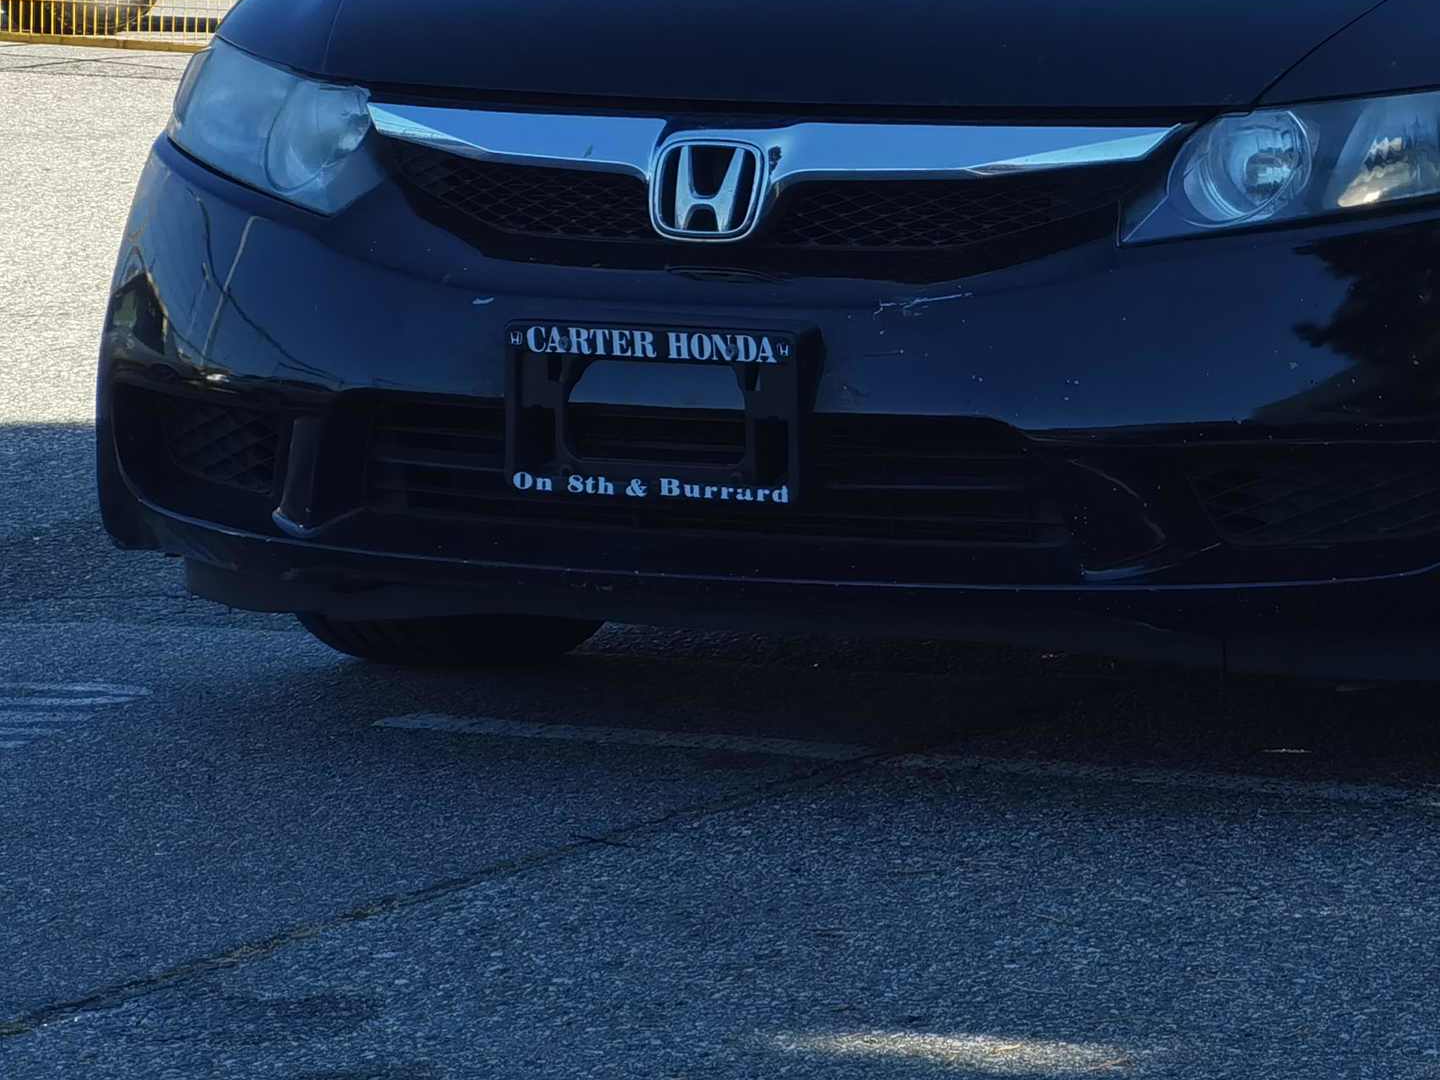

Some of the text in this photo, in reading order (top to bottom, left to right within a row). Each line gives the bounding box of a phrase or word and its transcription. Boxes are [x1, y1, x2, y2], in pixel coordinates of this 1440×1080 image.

[526, 326, 656, 359] CARTER
[667, 331, 777, 363] HONDA
[513, 471, 789, 503] On 8th & Burrard
